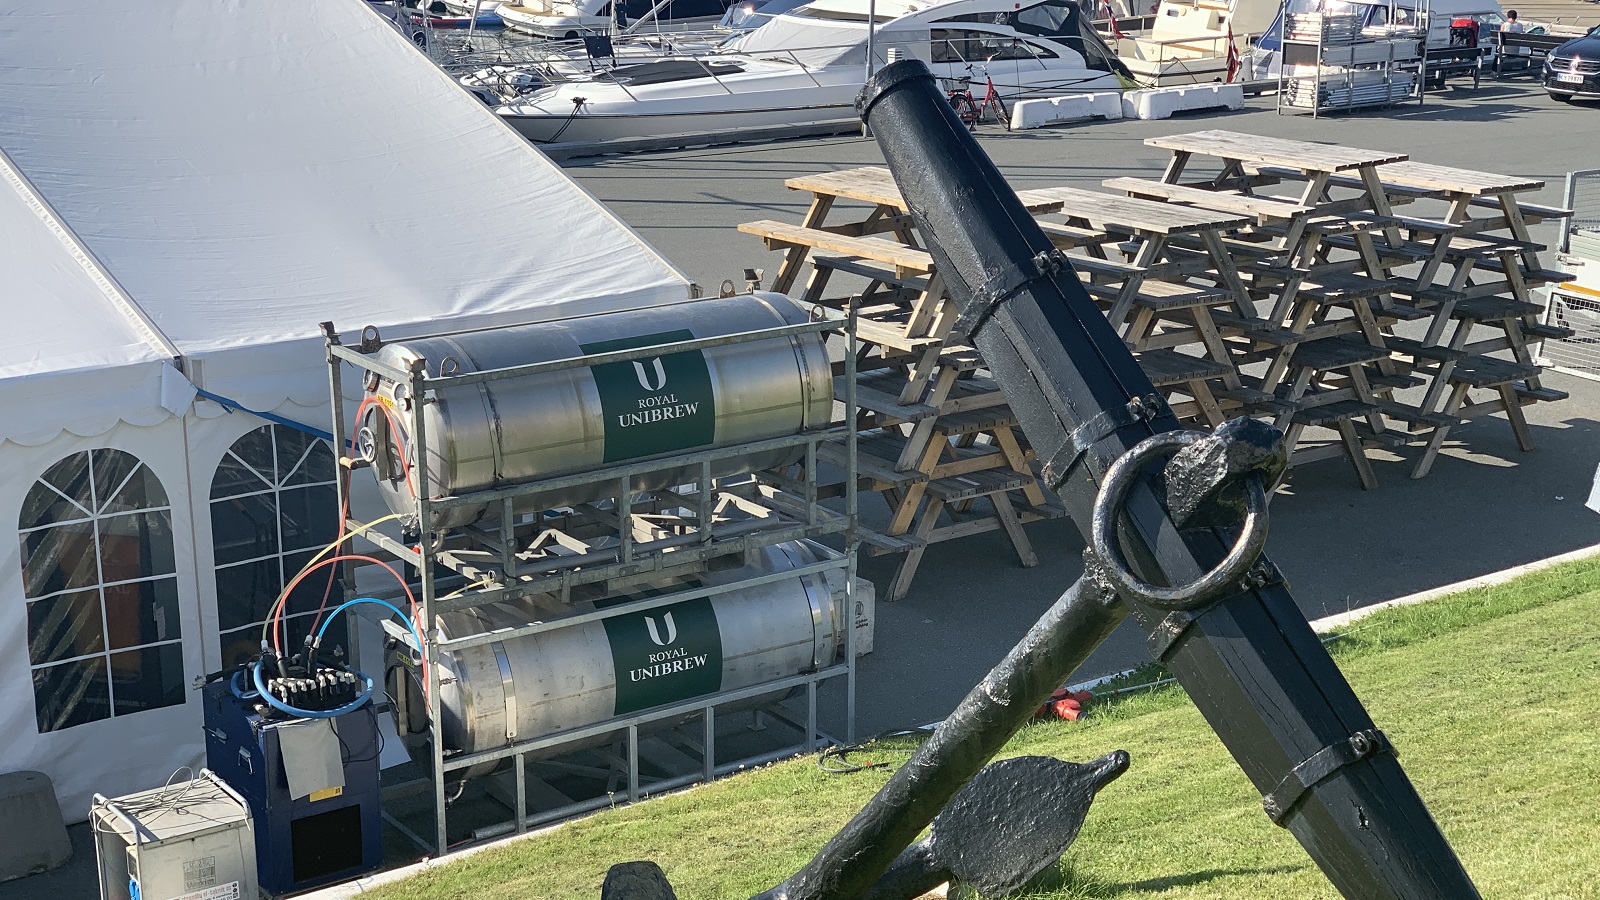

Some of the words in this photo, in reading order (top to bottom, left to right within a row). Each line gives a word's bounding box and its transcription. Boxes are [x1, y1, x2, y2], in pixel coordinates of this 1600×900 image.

[637, 393, 678, 409] ROYAL
[618, 401, 699, 428] UNIBREW
[648, 647, 688, 664] ROYAL
[629, 653, 708, 682] UNIBREW
